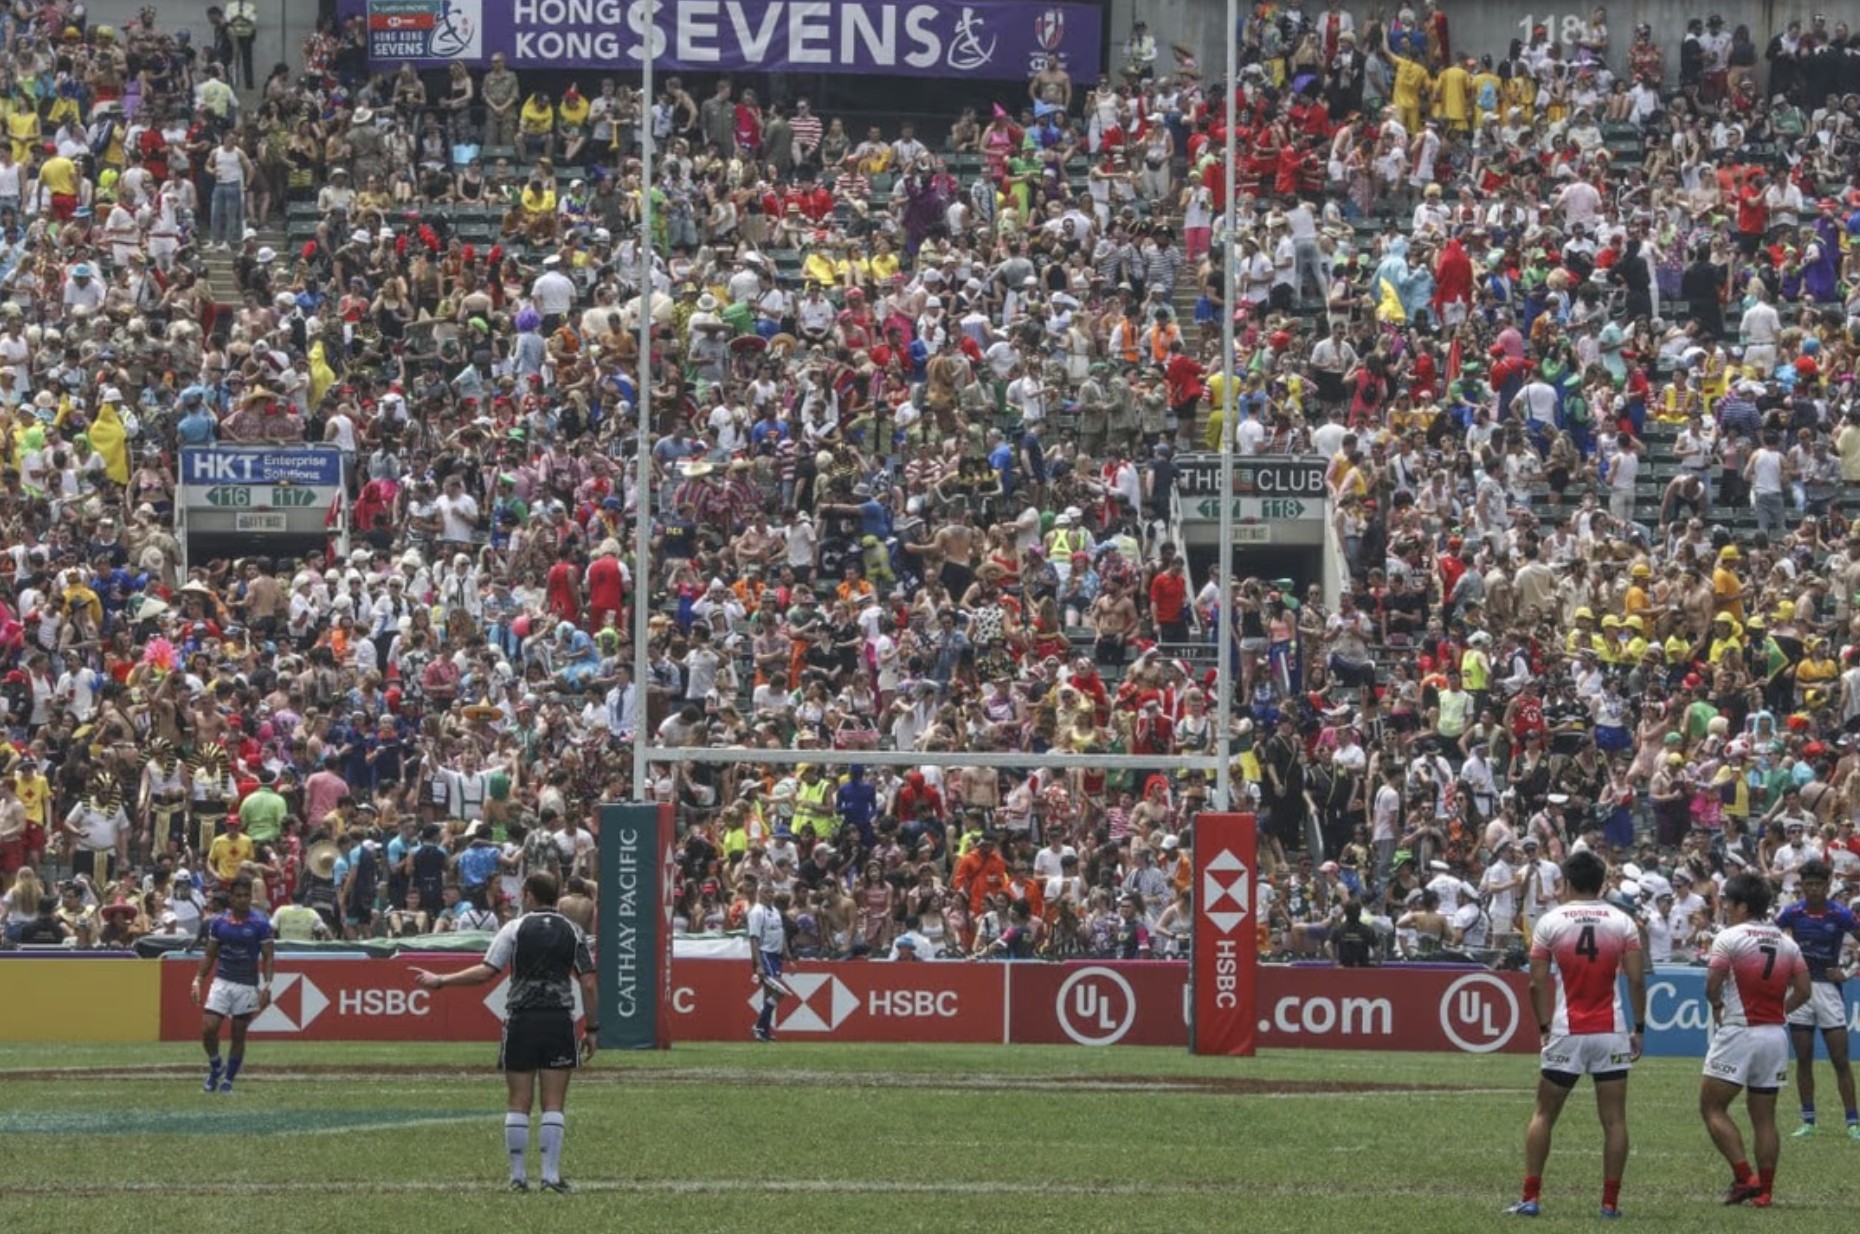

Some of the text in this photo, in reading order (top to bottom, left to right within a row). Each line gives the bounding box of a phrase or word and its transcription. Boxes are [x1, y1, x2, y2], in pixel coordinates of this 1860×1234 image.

[514, 0, 619, 24] HONG
[627, 0, 942, 67] SEVENS
[1518, 14, 1584, 45] 118
[374, 43, 423, 55] SEVENS
[516, 32, 619, 59] KONG
[194, 453, 259, 479] HKT
[263, 454, 327, 467] Enterprise
[263, 468, 321, 480] Solutions
[1257, 469, 1324, 491] CLUB
[213, 488, 308, 506] 116 117
[1265, 499, 1298, 517] 118
[618, 828, 638, 917] PACIFIC
[1561, 910, 1610, 918] TOSHIBA
[1575, 926, 1599, 963] 4
[618, 923, 637, 1017] CATHAY
[1216, 940, 1237, 1009] HSBC
[1760, 945, 1777, 980] 7
[339, 989, 431, 1016] HSBC
[868, 990, 958, 1017] HSBC
[1076, 985, 1116, 1030] UL
[1460, 990, 1500, 1036] UL
